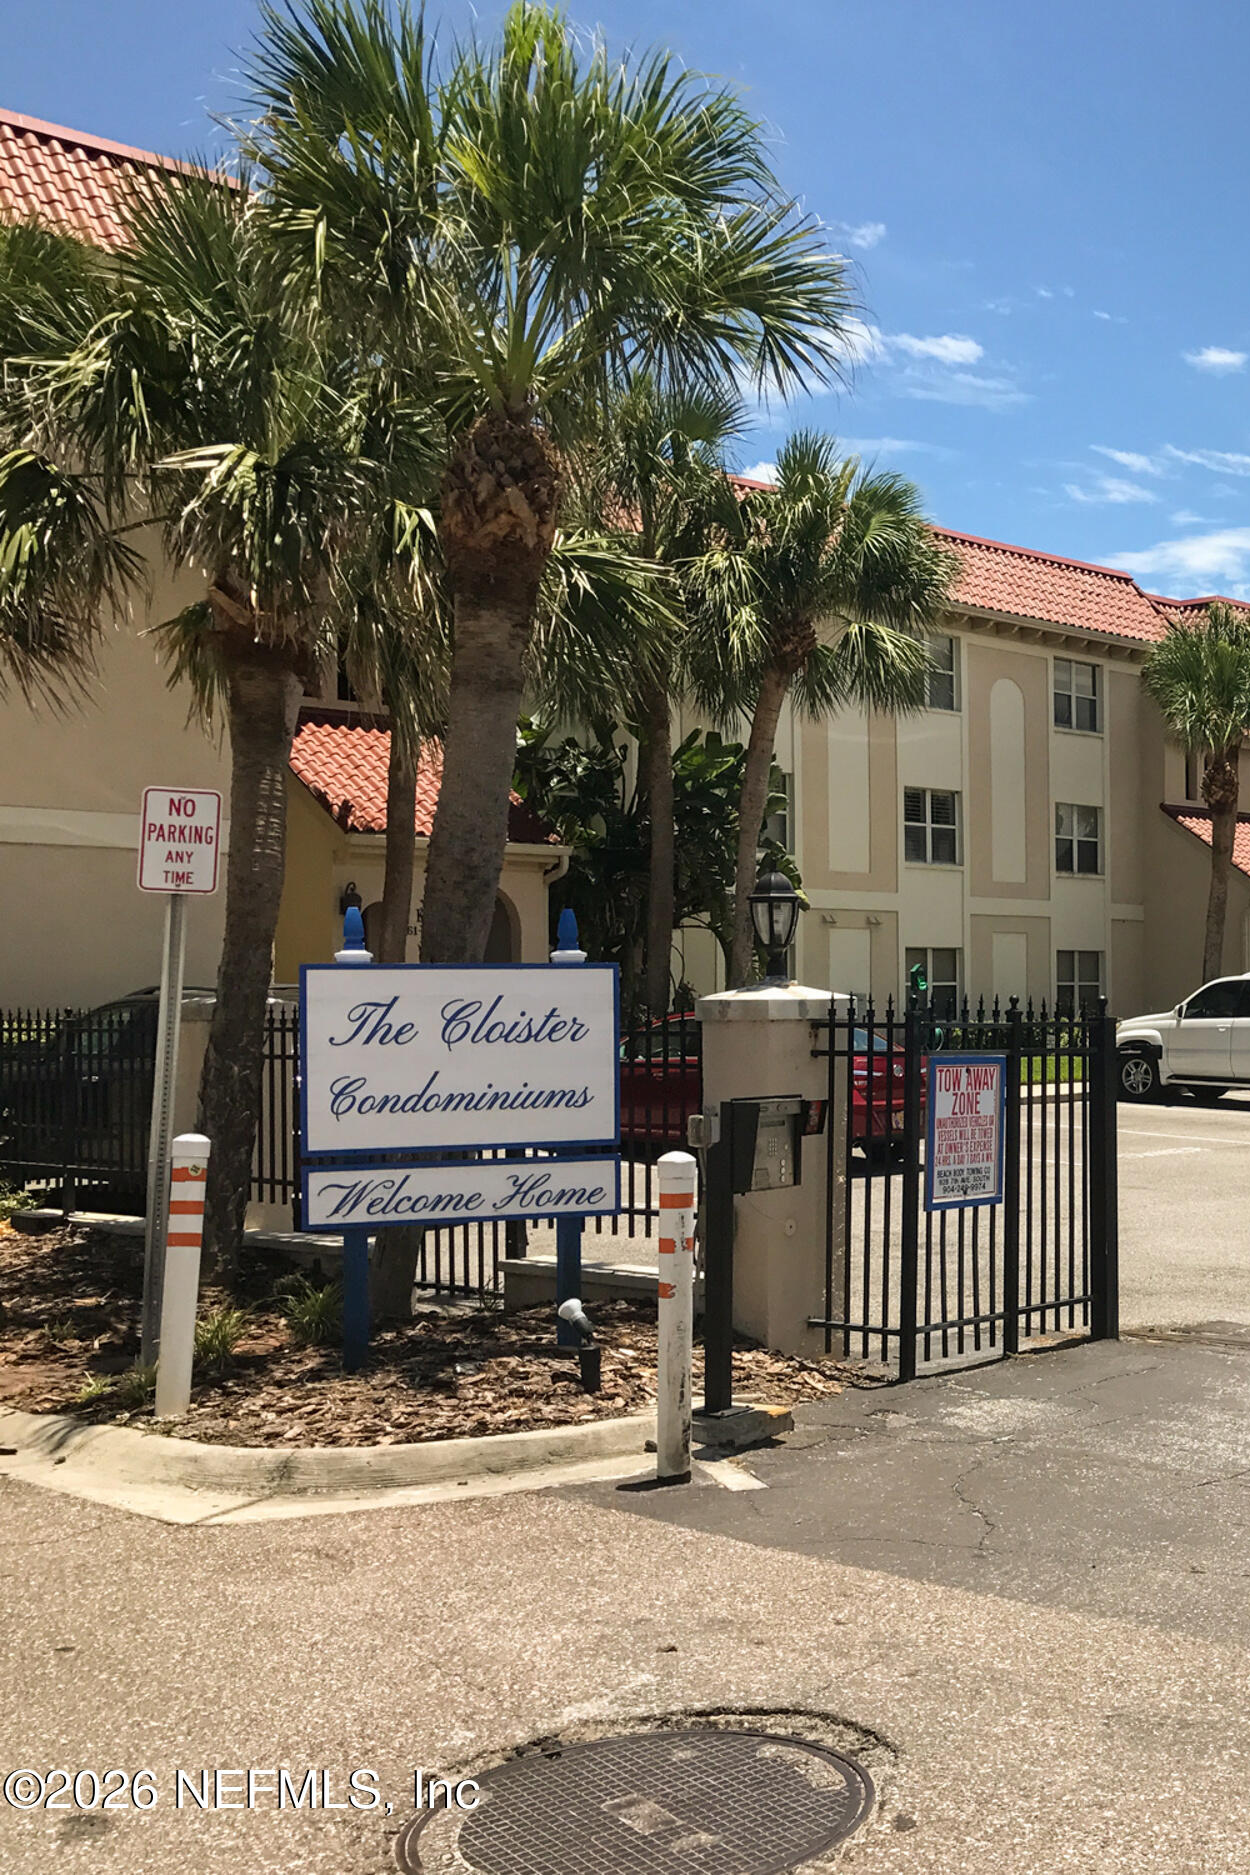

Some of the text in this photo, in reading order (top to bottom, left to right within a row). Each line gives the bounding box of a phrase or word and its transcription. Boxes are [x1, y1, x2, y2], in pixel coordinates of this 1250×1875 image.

[168, 797, 196, 818] NO
[147, 822, 214, 845] PARKING
[165, 850, 194, 864] ANY
[163, 870, 194, 885] TIME
[328, 994, 590, 1051] The Cloister
[938, 1067, 996, 1092] TOW AWAY
[329, 1071, 595, 1122] Condominiums
[952, 1092, 981, 1116] ZONE
[938, 1127, 993, 1142] VESSELS WILL BE TOWED
[938, 1143, 944, 1155] AT
[970, 1139, 993, 1153] EXPENSE
[318, 1173, 607, 1219] Welcome Home
